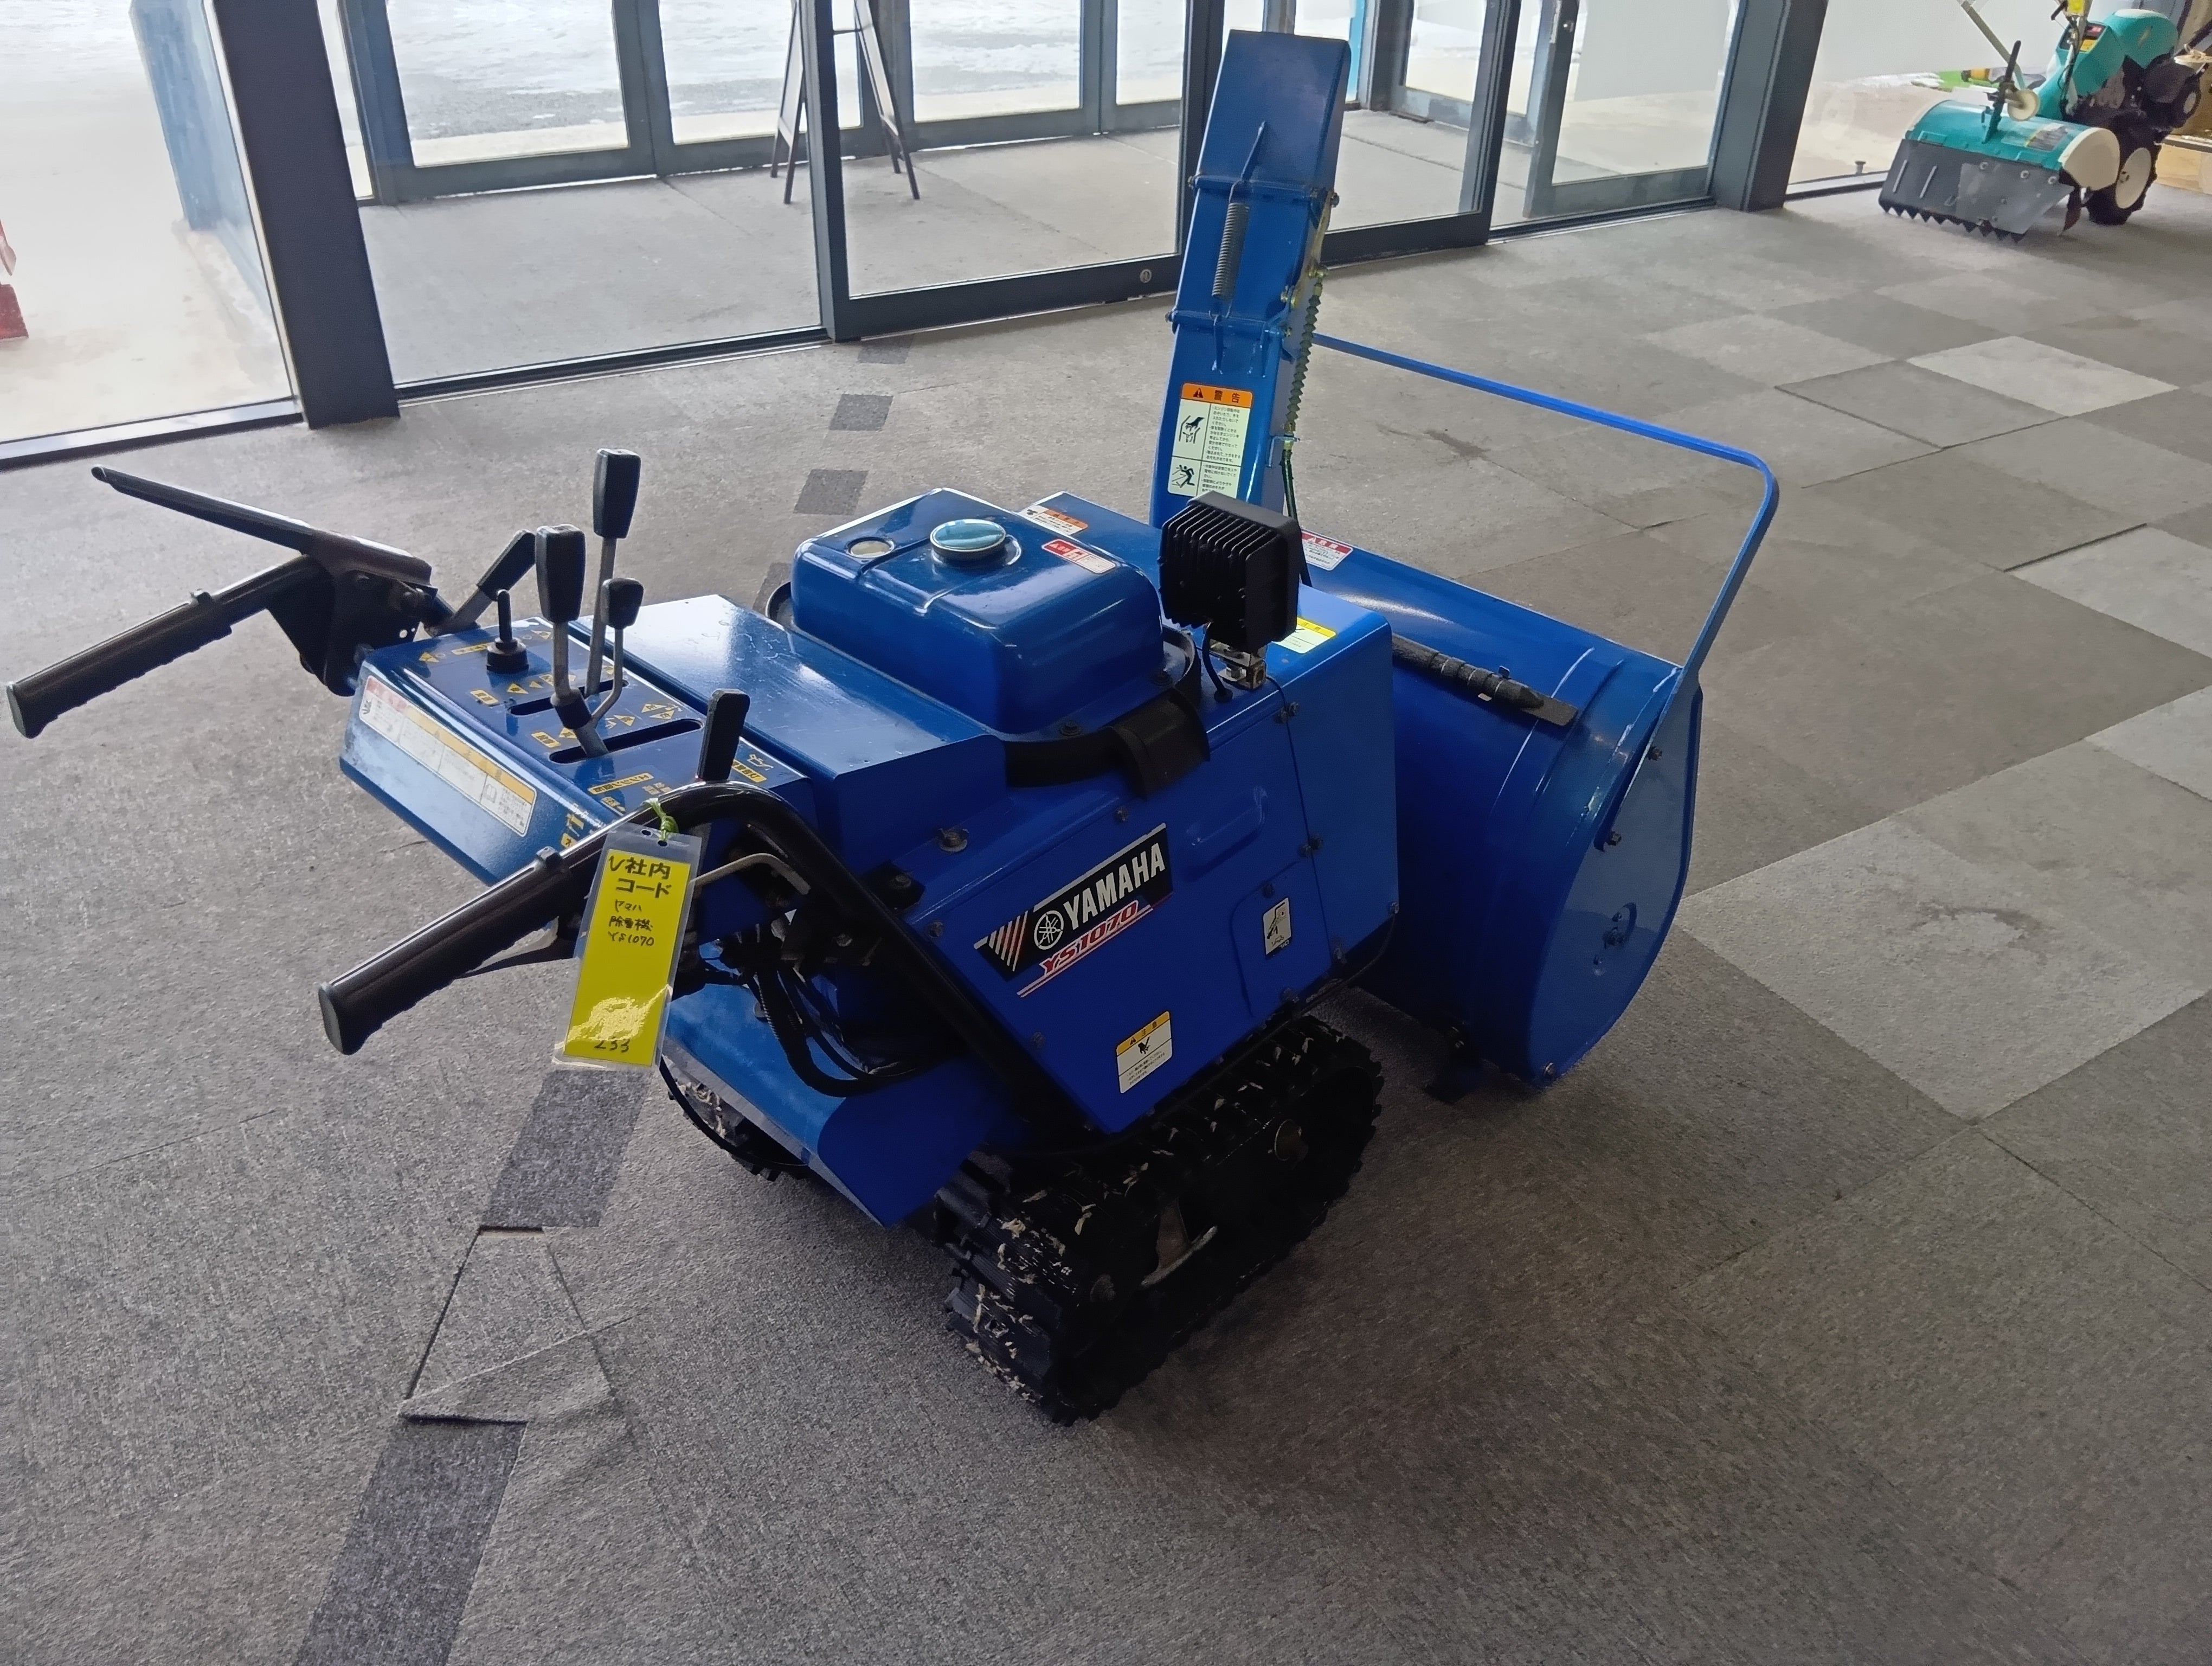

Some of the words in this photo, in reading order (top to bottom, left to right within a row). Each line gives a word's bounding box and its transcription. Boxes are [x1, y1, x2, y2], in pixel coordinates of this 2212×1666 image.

[615, 899, 642, 912] ヤマハ
[616, 878, 672, 899] コード
[1063, 842, 1165, 930] YAMAHA
[1039, 900, 1139, 977] YS1070
